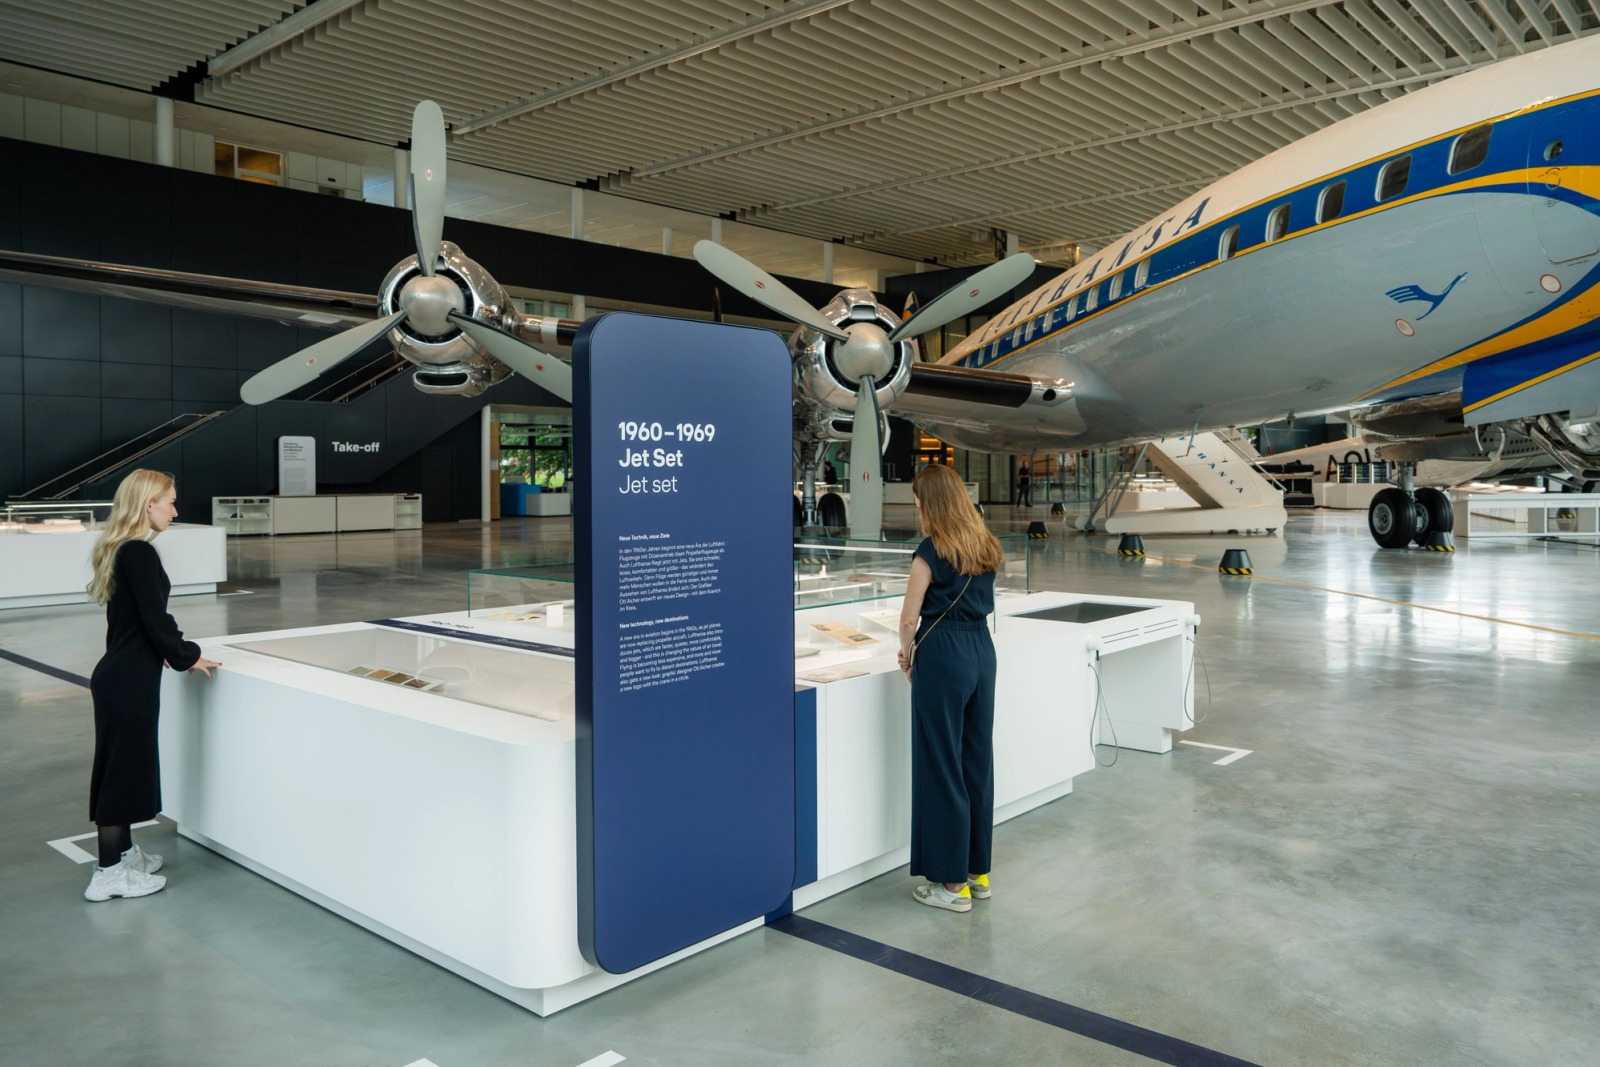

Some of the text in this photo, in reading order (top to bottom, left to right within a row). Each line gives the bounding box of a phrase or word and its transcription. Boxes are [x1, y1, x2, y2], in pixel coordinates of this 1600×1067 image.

[331, 441, 381, 453] Take-off
[618, 447, 684, 468] Jet Set
[618, 474, 678, 494] Jet set
